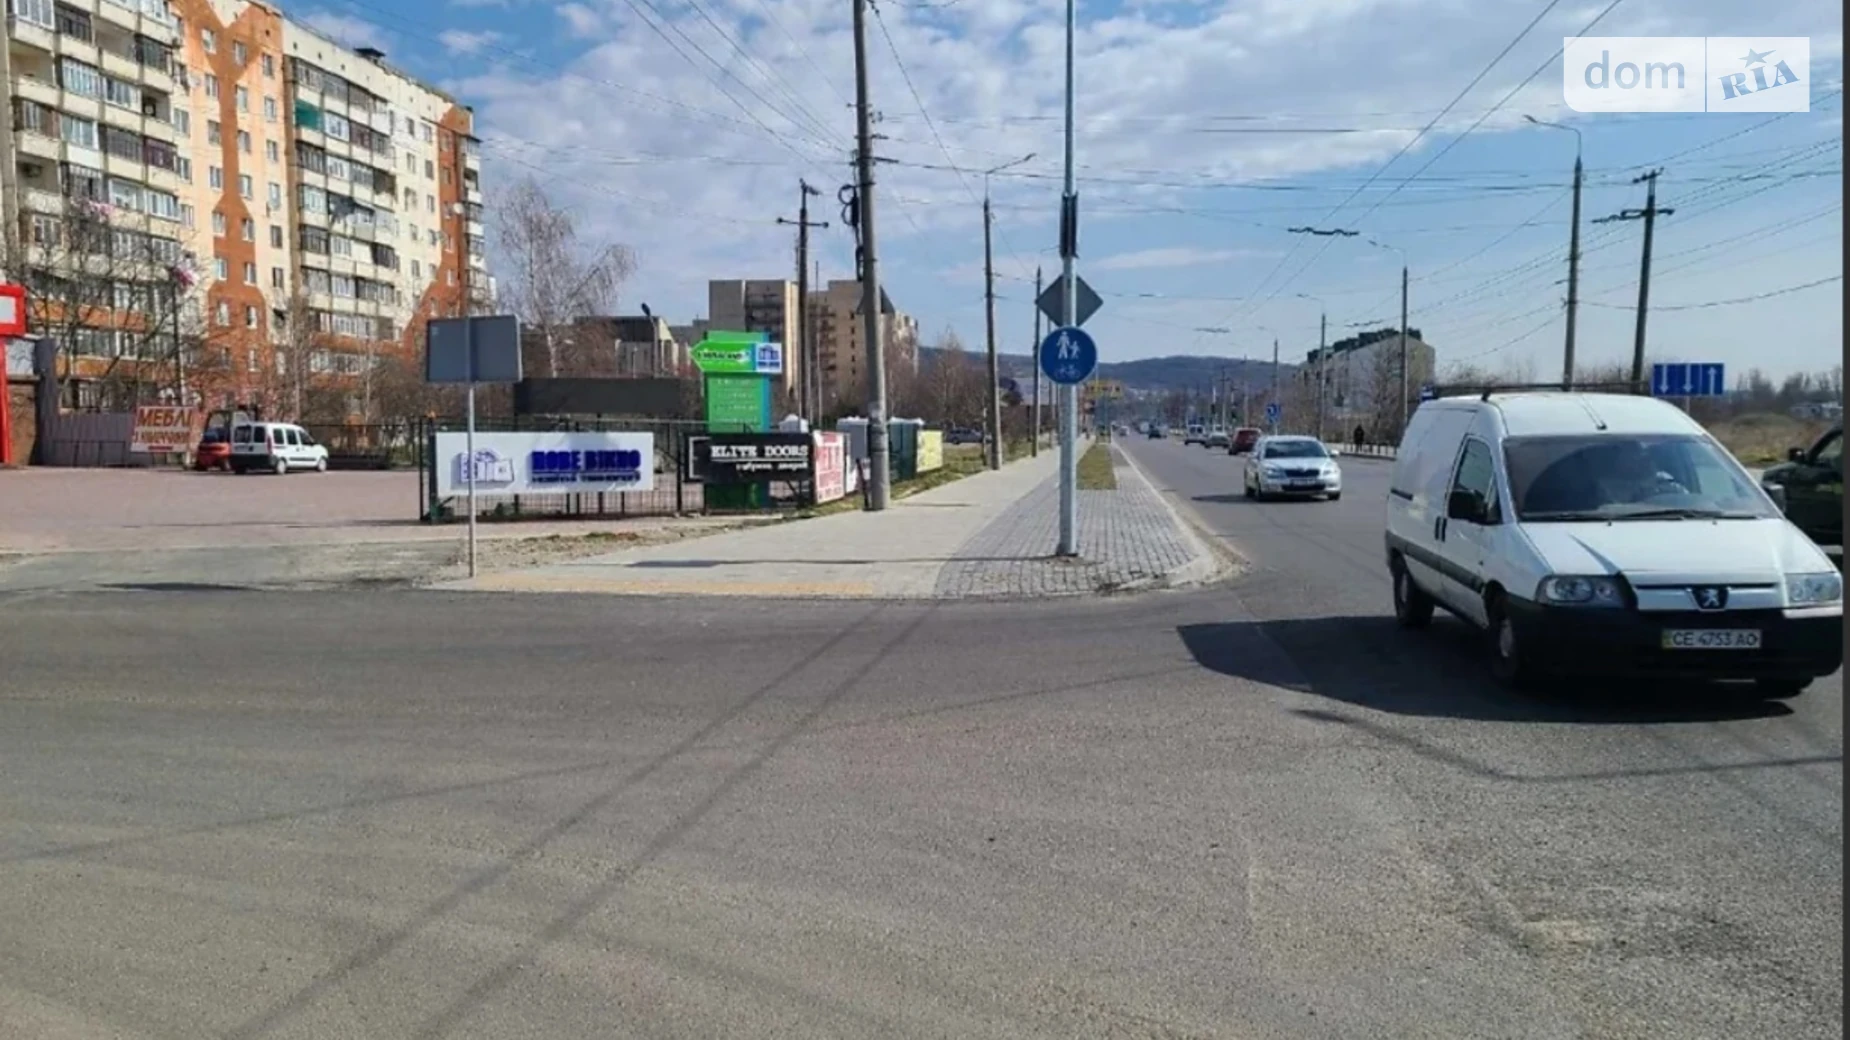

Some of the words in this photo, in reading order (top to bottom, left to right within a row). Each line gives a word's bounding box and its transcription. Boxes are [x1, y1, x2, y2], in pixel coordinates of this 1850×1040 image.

[138, 408, 193, 427] МЕБЛІ
[711, 445, 757, 457] ELITE
[764, 445, 808, 456] DOORS
[1673, 632, 1694, 646] CE
[1697, 632, 1731, 646] 4753
